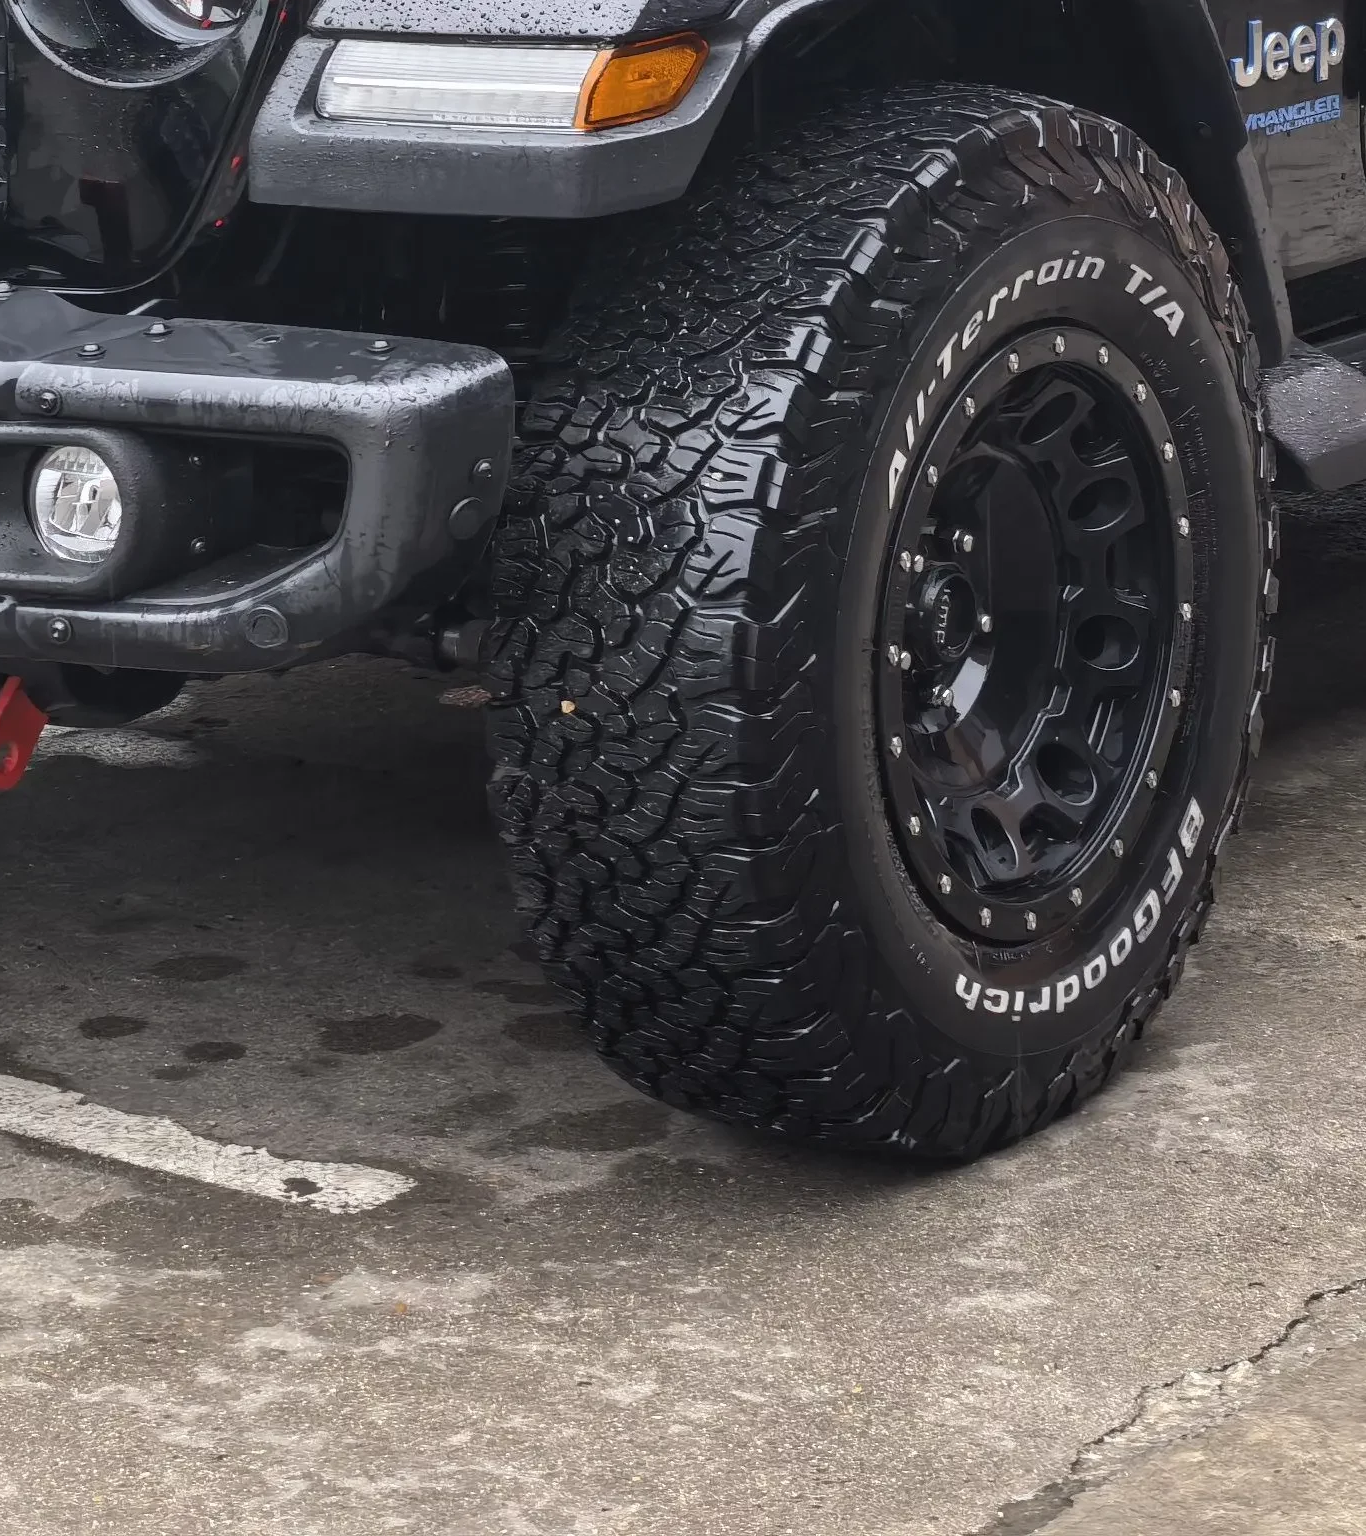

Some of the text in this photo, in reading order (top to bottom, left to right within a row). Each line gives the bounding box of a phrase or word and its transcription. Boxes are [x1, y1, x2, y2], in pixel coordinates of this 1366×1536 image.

[1229, 17, 1346, 88] Jeep
[888, 249, 1106, 510] All-Terrain
[954, 795, 1205, 1022] BFGoodrich
